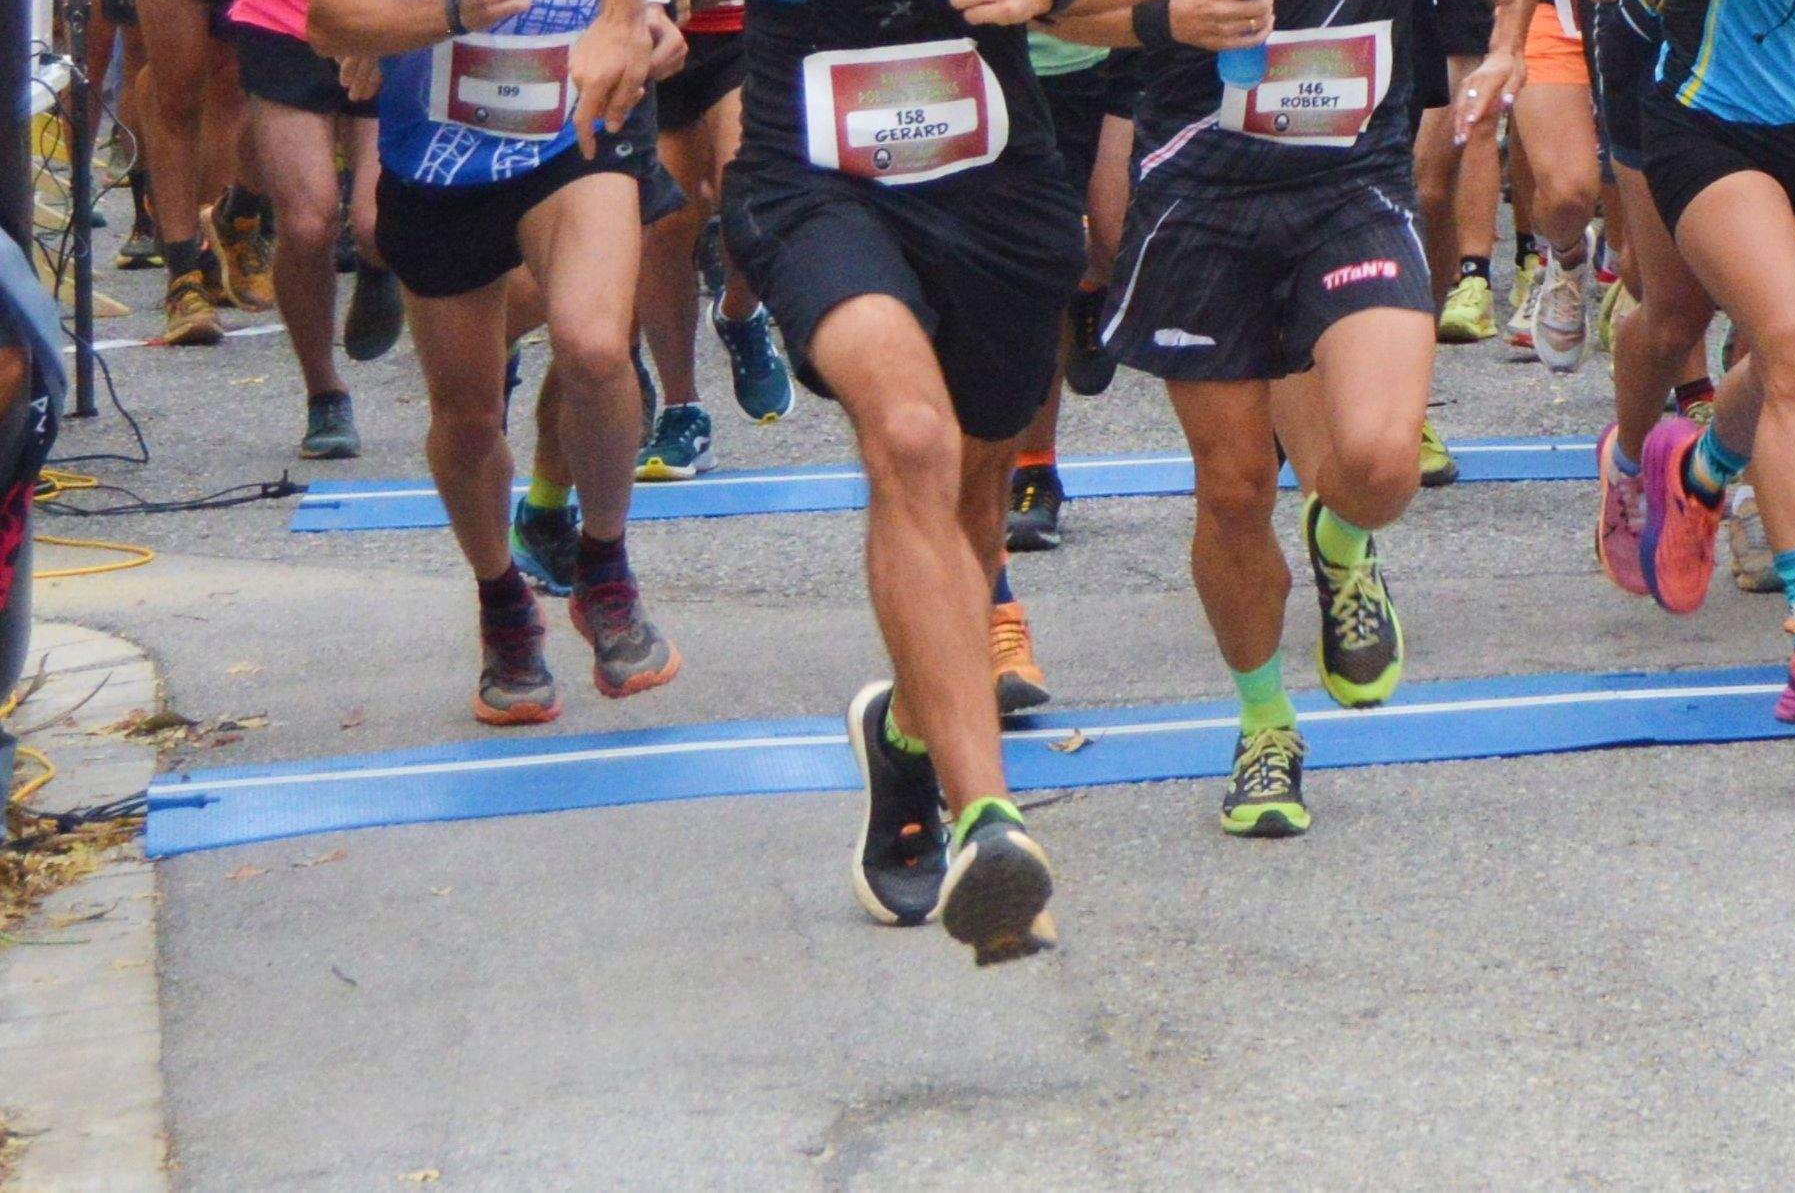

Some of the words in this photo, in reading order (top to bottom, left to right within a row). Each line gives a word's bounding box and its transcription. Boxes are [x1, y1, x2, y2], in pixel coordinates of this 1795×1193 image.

[497, 85, 520, 97] 199
[1298, 82, 1324, 95] 146
[1280, 95, 1341, 108] ROBERT
[895, 108, 926, 126] 158
[874, 121, 949, 144] GERARD
